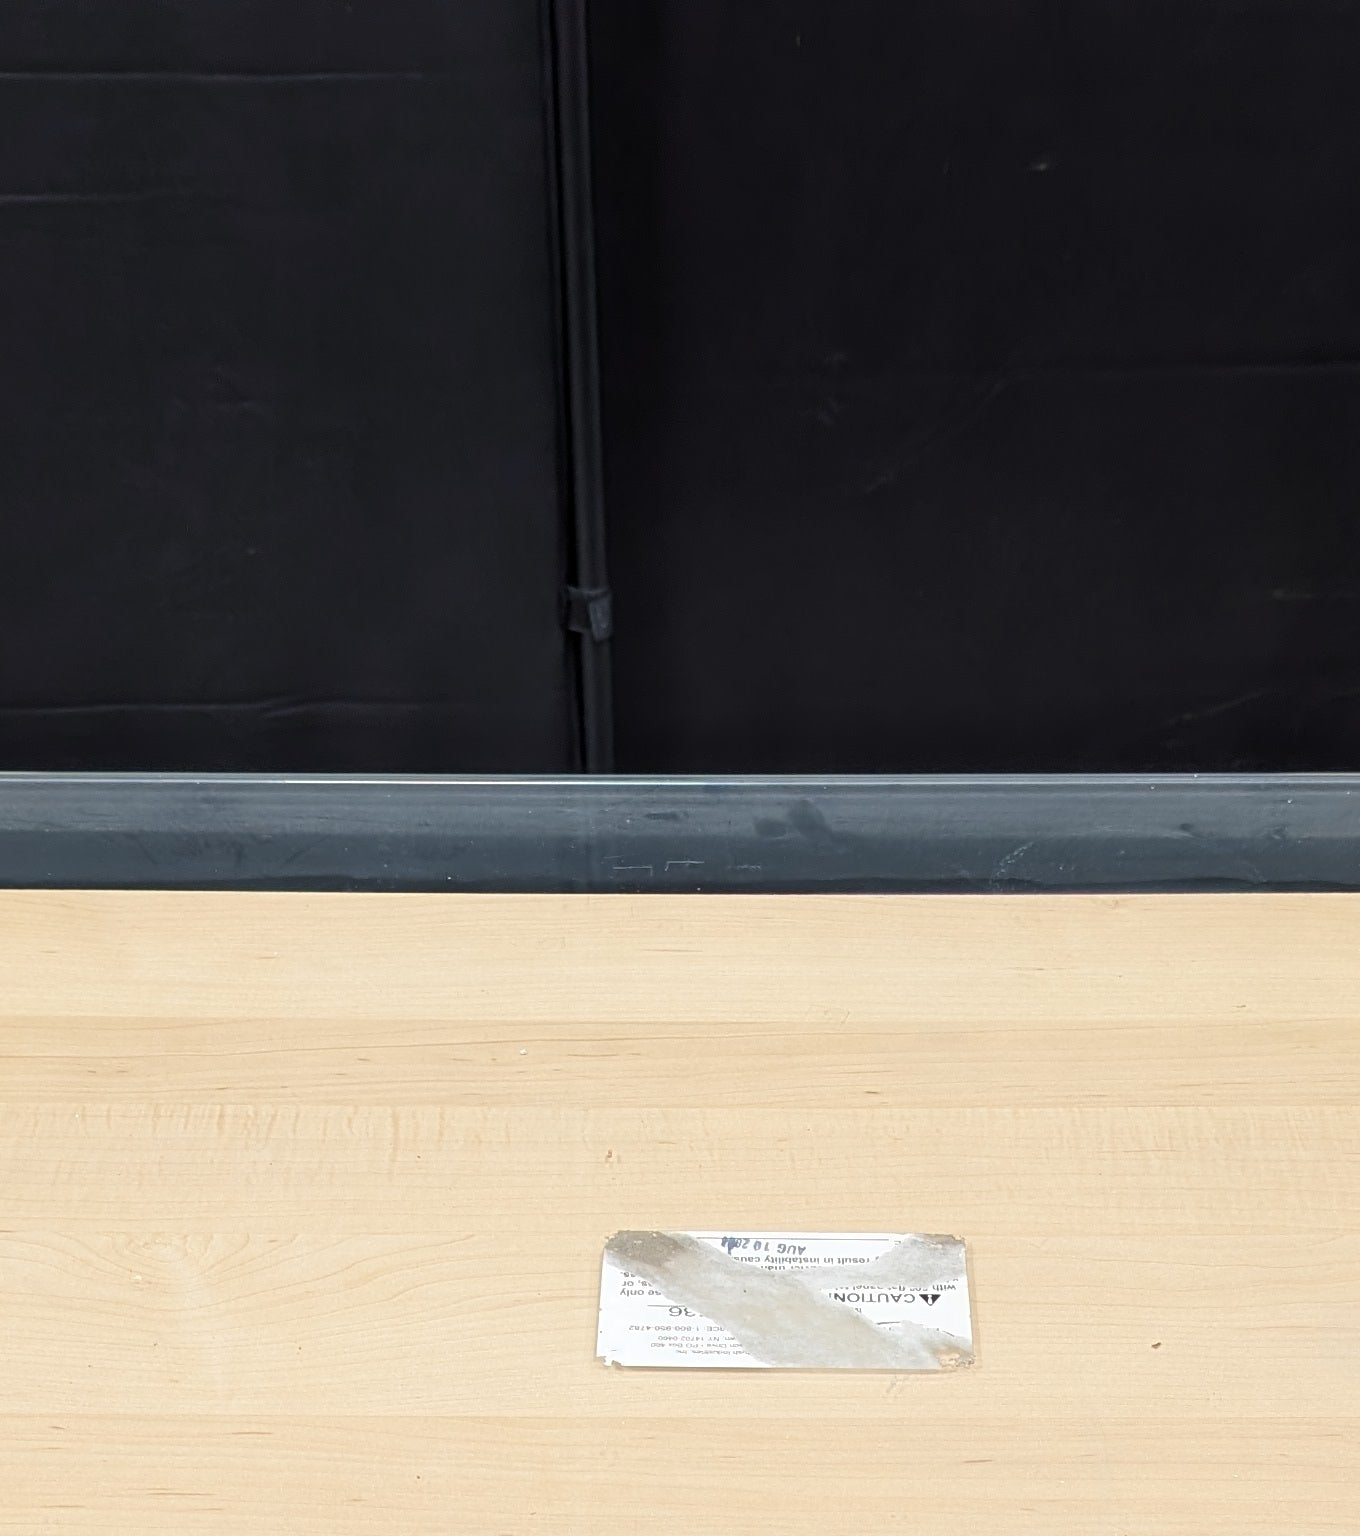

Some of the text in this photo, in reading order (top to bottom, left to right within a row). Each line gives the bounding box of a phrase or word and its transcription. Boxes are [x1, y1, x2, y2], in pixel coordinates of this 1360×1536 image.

[777, 1243, 806, 1255] AUG
[765, 1255, 819, 1264] instability
[620, 1288, 644, 1297] only
